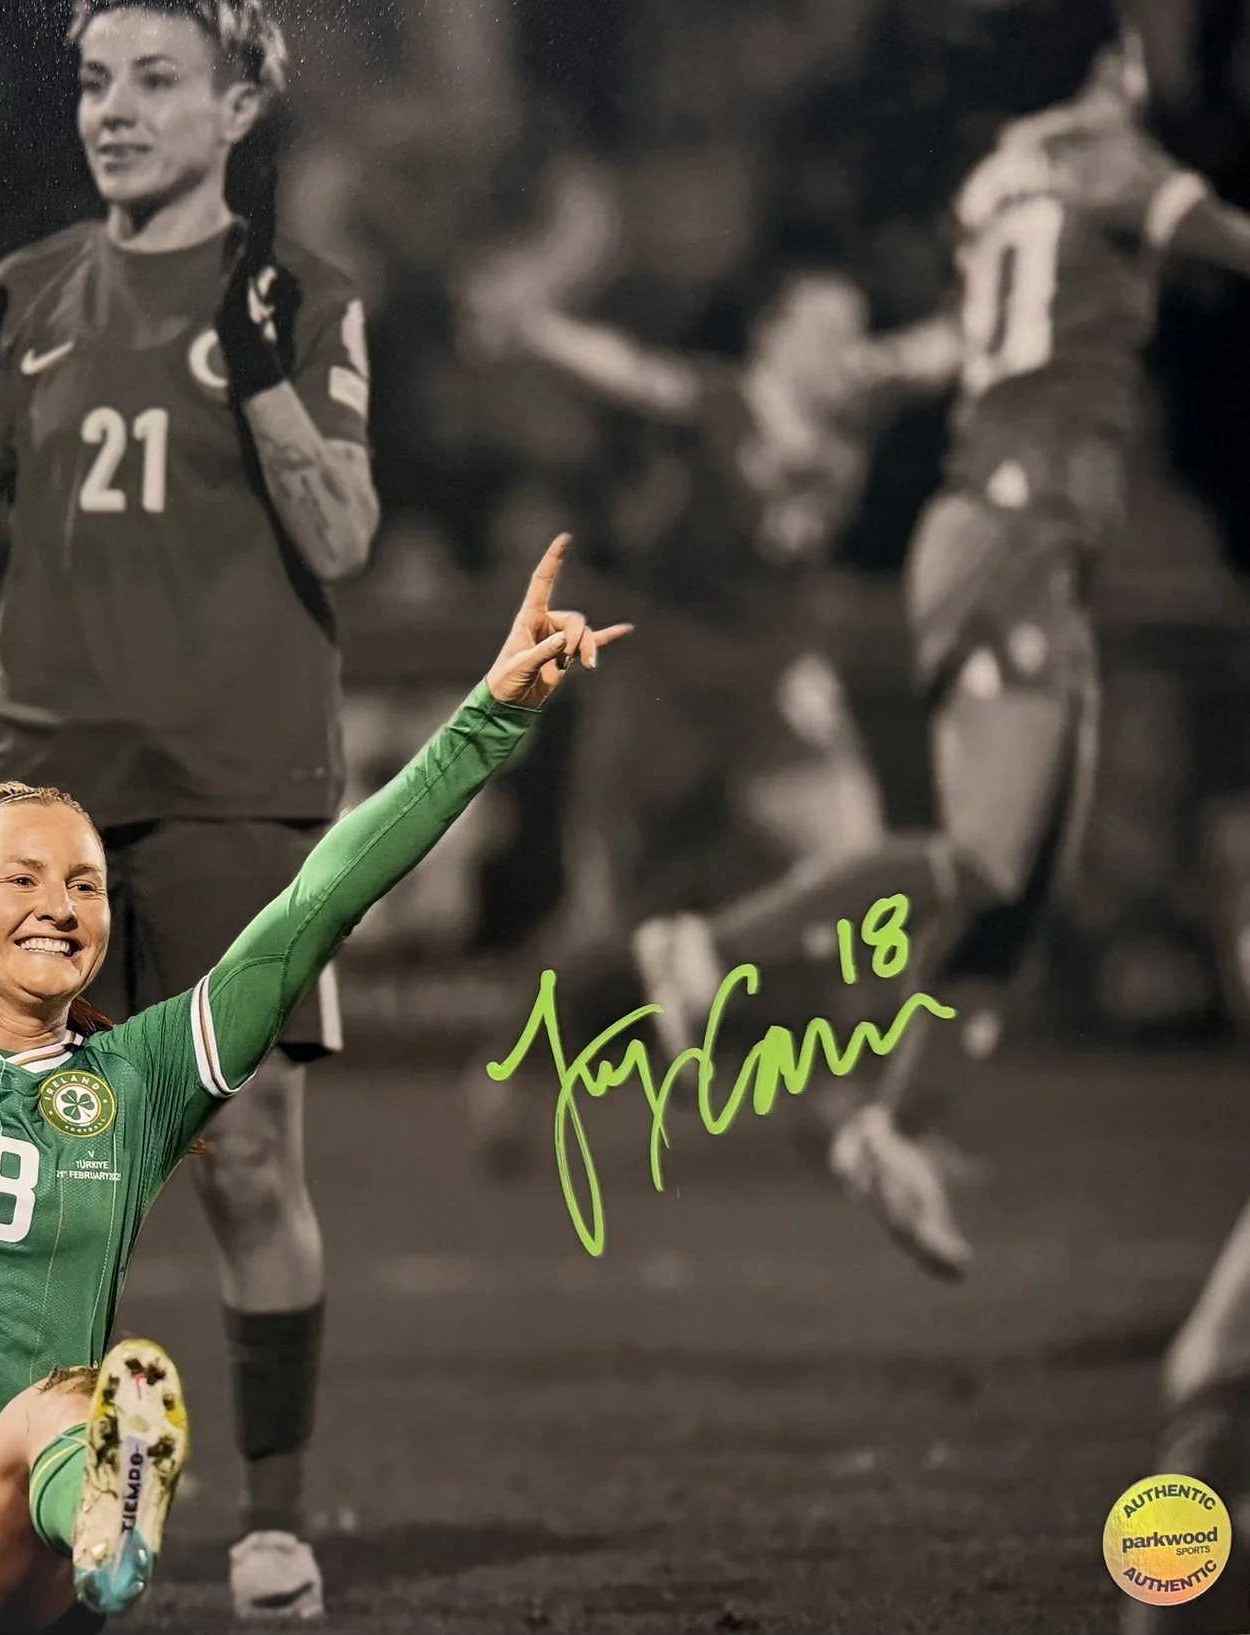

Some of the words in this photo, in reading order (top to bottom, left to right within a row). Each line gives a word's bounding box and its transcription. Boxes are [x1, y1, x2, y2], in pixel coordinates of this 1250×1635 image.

[79, 406, 169, 514] 21
[836, 893, 910, 985] 18
[43, 1074, 100, 1100] IRELAND
[69, 1170, 110, 1180] FEBRUARY
[1122, 1484, 1216, 1518] AUTHENTIC
[1122, 1527, 1218, 1553] parkwood
[1176, 1545, 1211, 1556] SPORTS
[1122, 1559, 1217, 1592] AUTHENTIC
